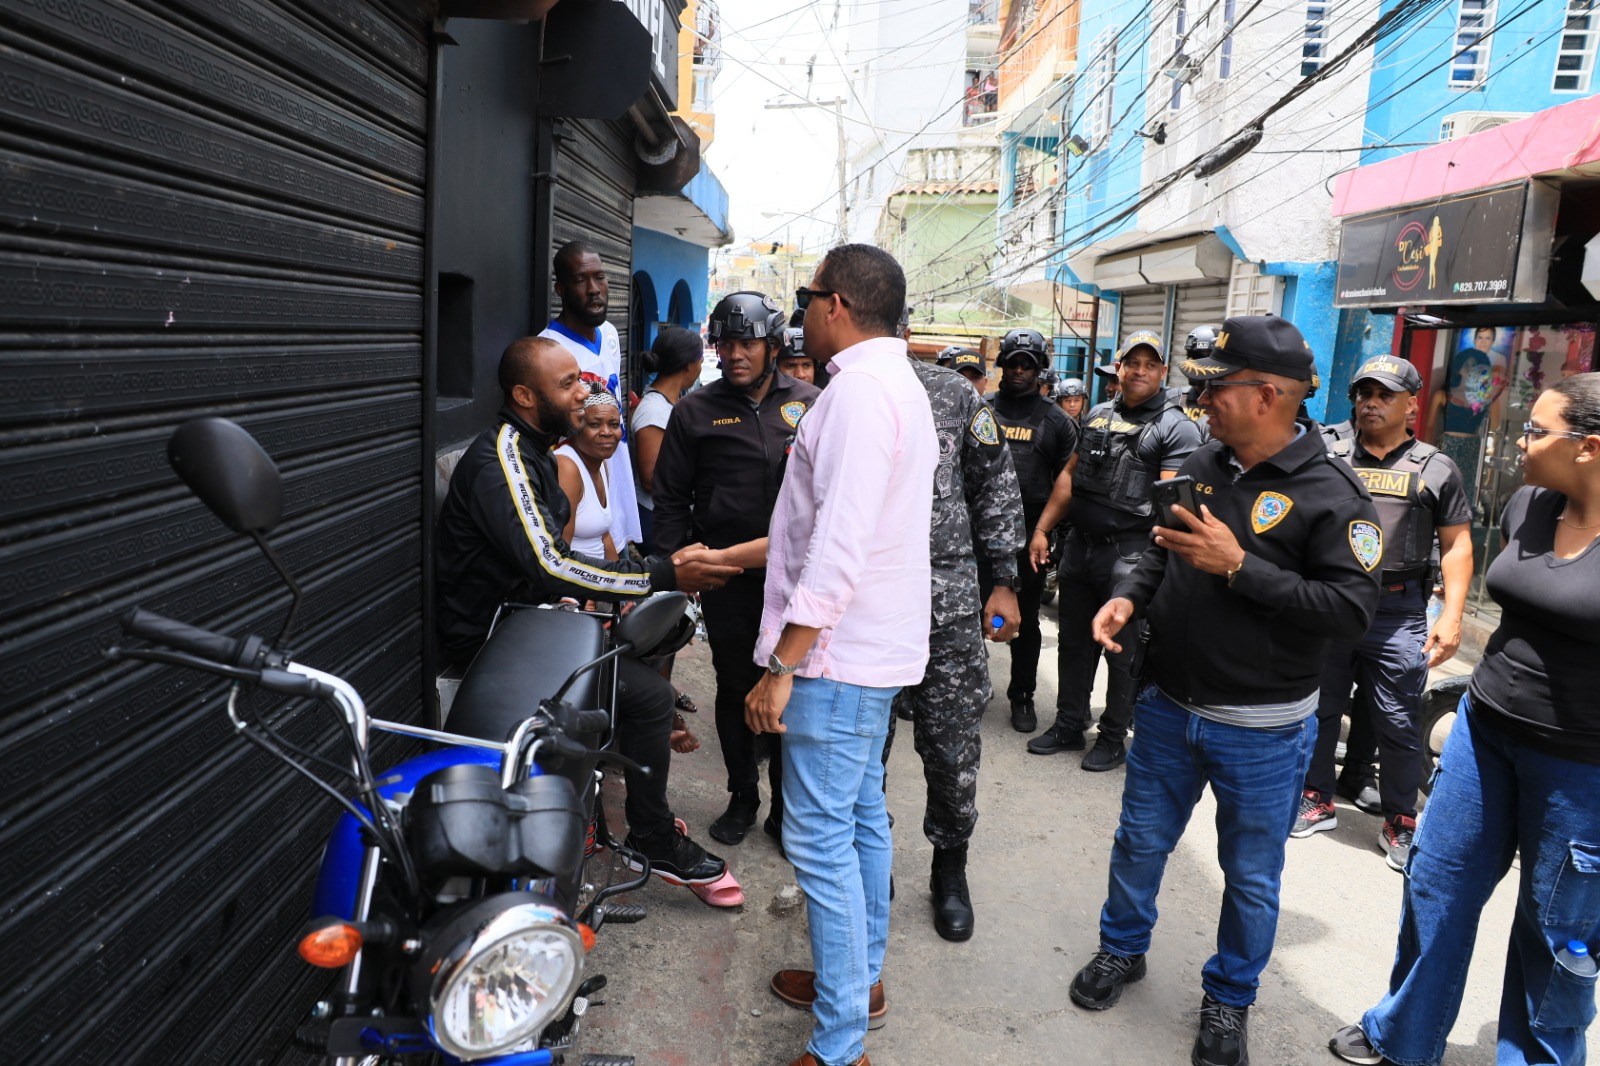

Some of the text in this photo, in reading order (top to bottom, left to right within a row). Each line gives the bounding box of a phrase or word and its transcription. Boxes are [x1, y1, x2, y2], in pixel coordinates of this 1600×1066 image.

[1460, 280, 1508, 292] 829.707.3998
[956, 354, 980, 365] DICRIM
[1363, 362, 1399, 374] DICRIM
[712, 416, 742, 427] MORA
[1356, 472, 1404, 493] CRIM
[519, 483, 540, 528] ROCKSTAR
[569, 566, 616, 585] ROCKSTAR
